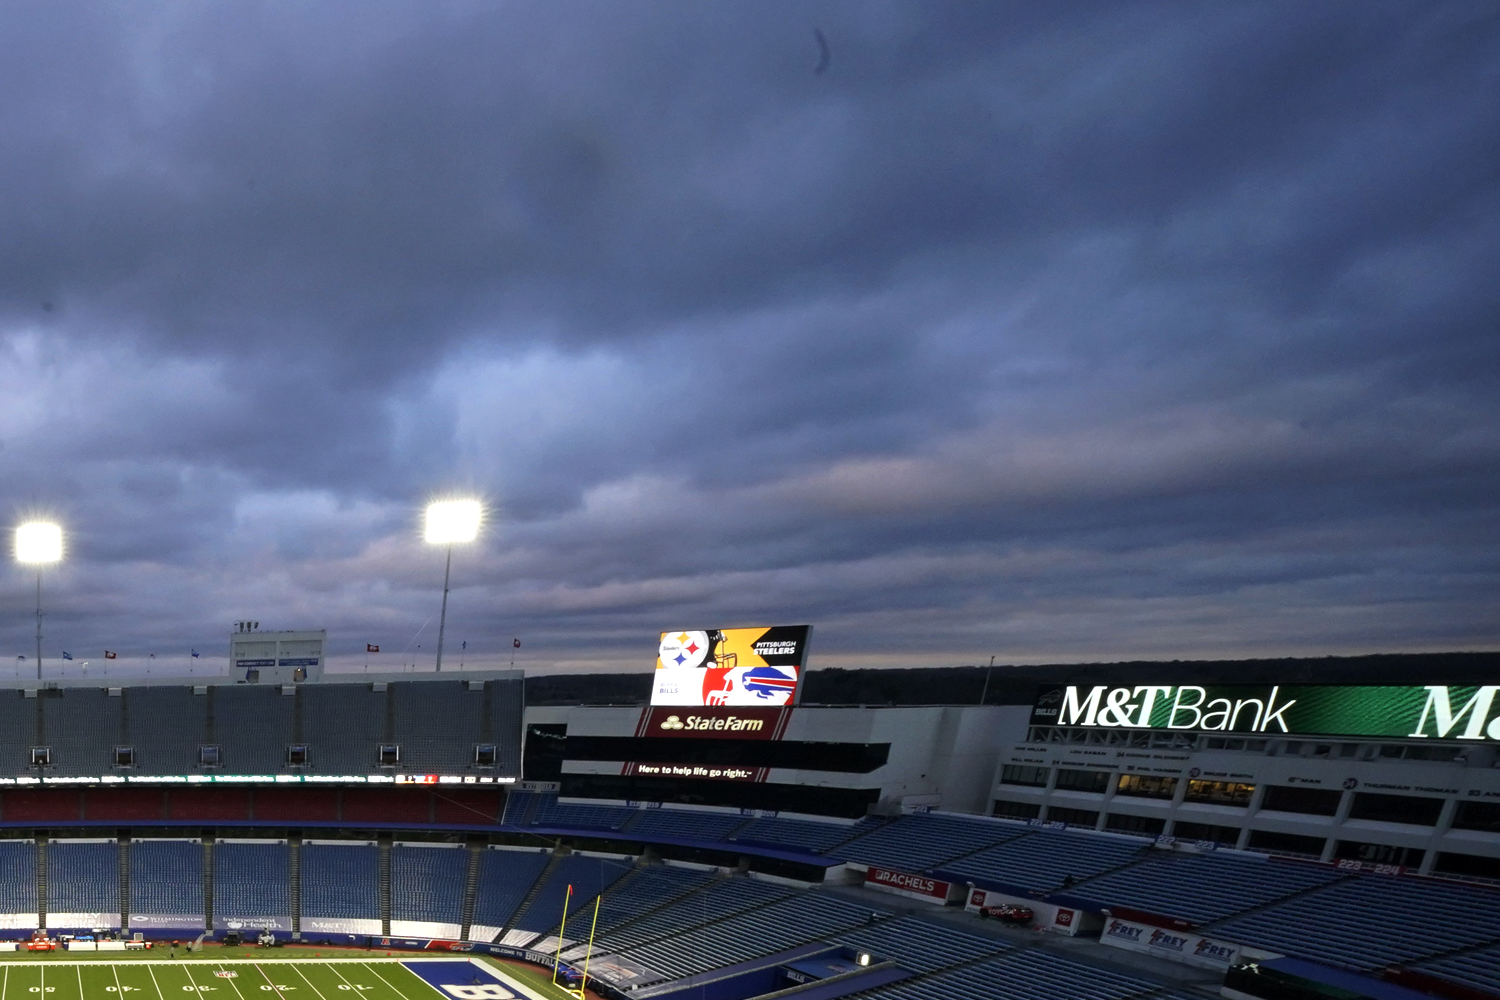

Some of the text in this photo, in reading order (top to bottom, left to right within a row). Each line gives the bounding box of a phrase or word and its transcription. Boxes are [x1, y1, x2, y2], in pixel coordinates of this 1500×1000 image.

[756, 641, 796, 649] PITTSBURGH
[753, 647, 795, 656] STEELERS
[1034, 708, 1057, 716] BILLS
[1056, 684, 1297, 733] M&T Bank
[638, 765, 660, 774] Here
[662, 766, 672, 774] to
[672, 766, 692, 777] help
[693, 767, 708, 776] life
[709, 769, 722, 778] go
[1363, 782, 1459, 794] THURMAN THOMAS
[1030, 818, 1043, 826] 221
[1048, 820, 1065, 830] 222
[1196, 840, 1215, 850] 223
[1337, 859, 1362, 871] 223
[1375, 863, 1400, 876] 224
[884, 871, 935, 892] RACHEL'S
[988, 908, 1015, 916] TOYOTA
[222, 916, 275, 924] Independent
[242, 920, 282, 929] Health
[1113, 922, 1144, 938] FREY
[1156, 932, 1188, 948] FREY
[490, 946, 523, 958] WELCOME TO
[1202, 942, 1236, 958] FREY
